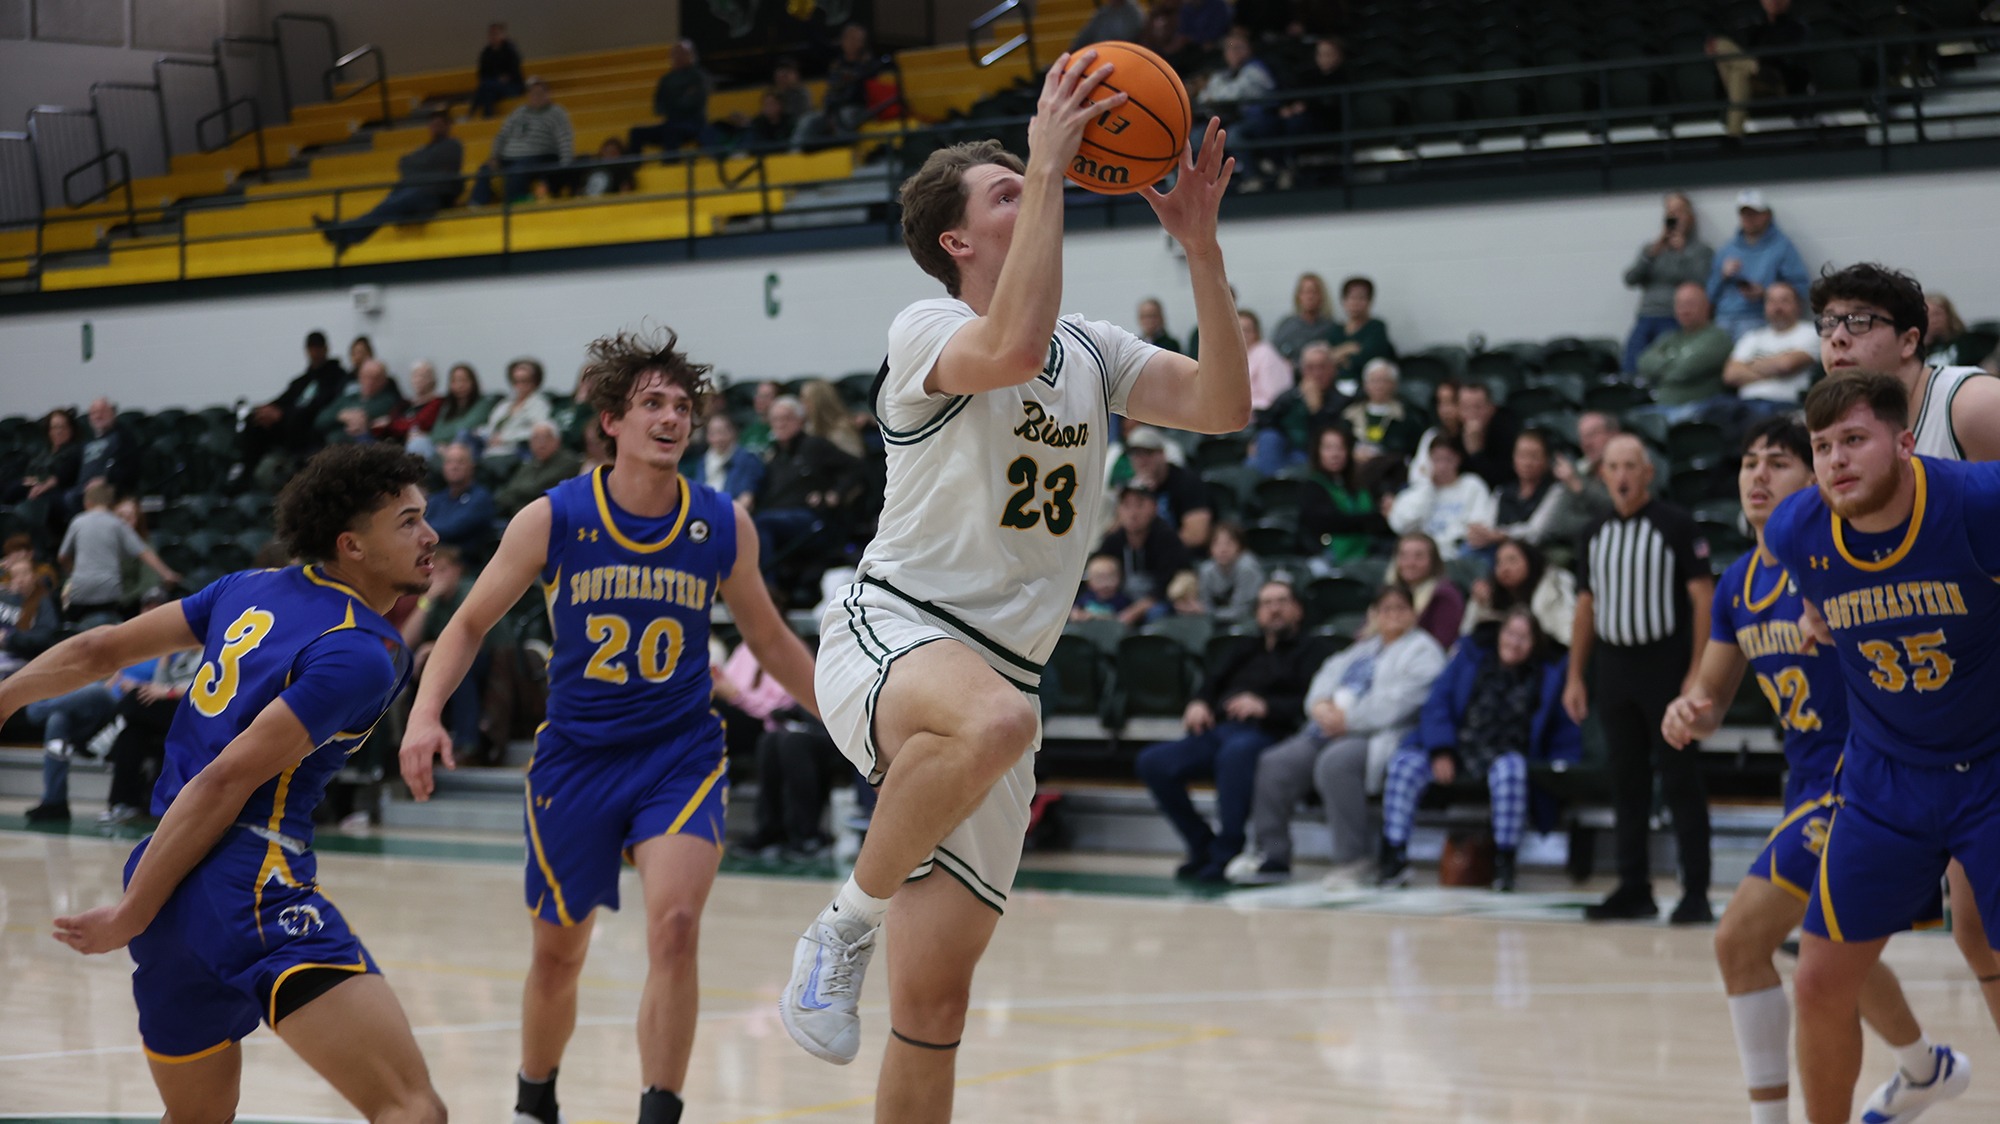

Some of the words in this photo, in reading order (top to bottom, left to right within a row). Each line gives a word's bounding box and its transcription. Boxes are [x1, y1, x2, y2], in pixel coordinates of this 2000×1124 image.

[764, 273, 781, 319] C
[1014, 400, 1089, 448] Bison
[999, 454, 1079, 537] 23
[570, 565, 707, 611] SOUTHEASTERN
[1823, 581, 1968, 630] SOUTHEASTERN
[189, 605, 275, 718] 3
[583, 612, 685, 685] 20
[1857, 628, 1956, 693] 35
